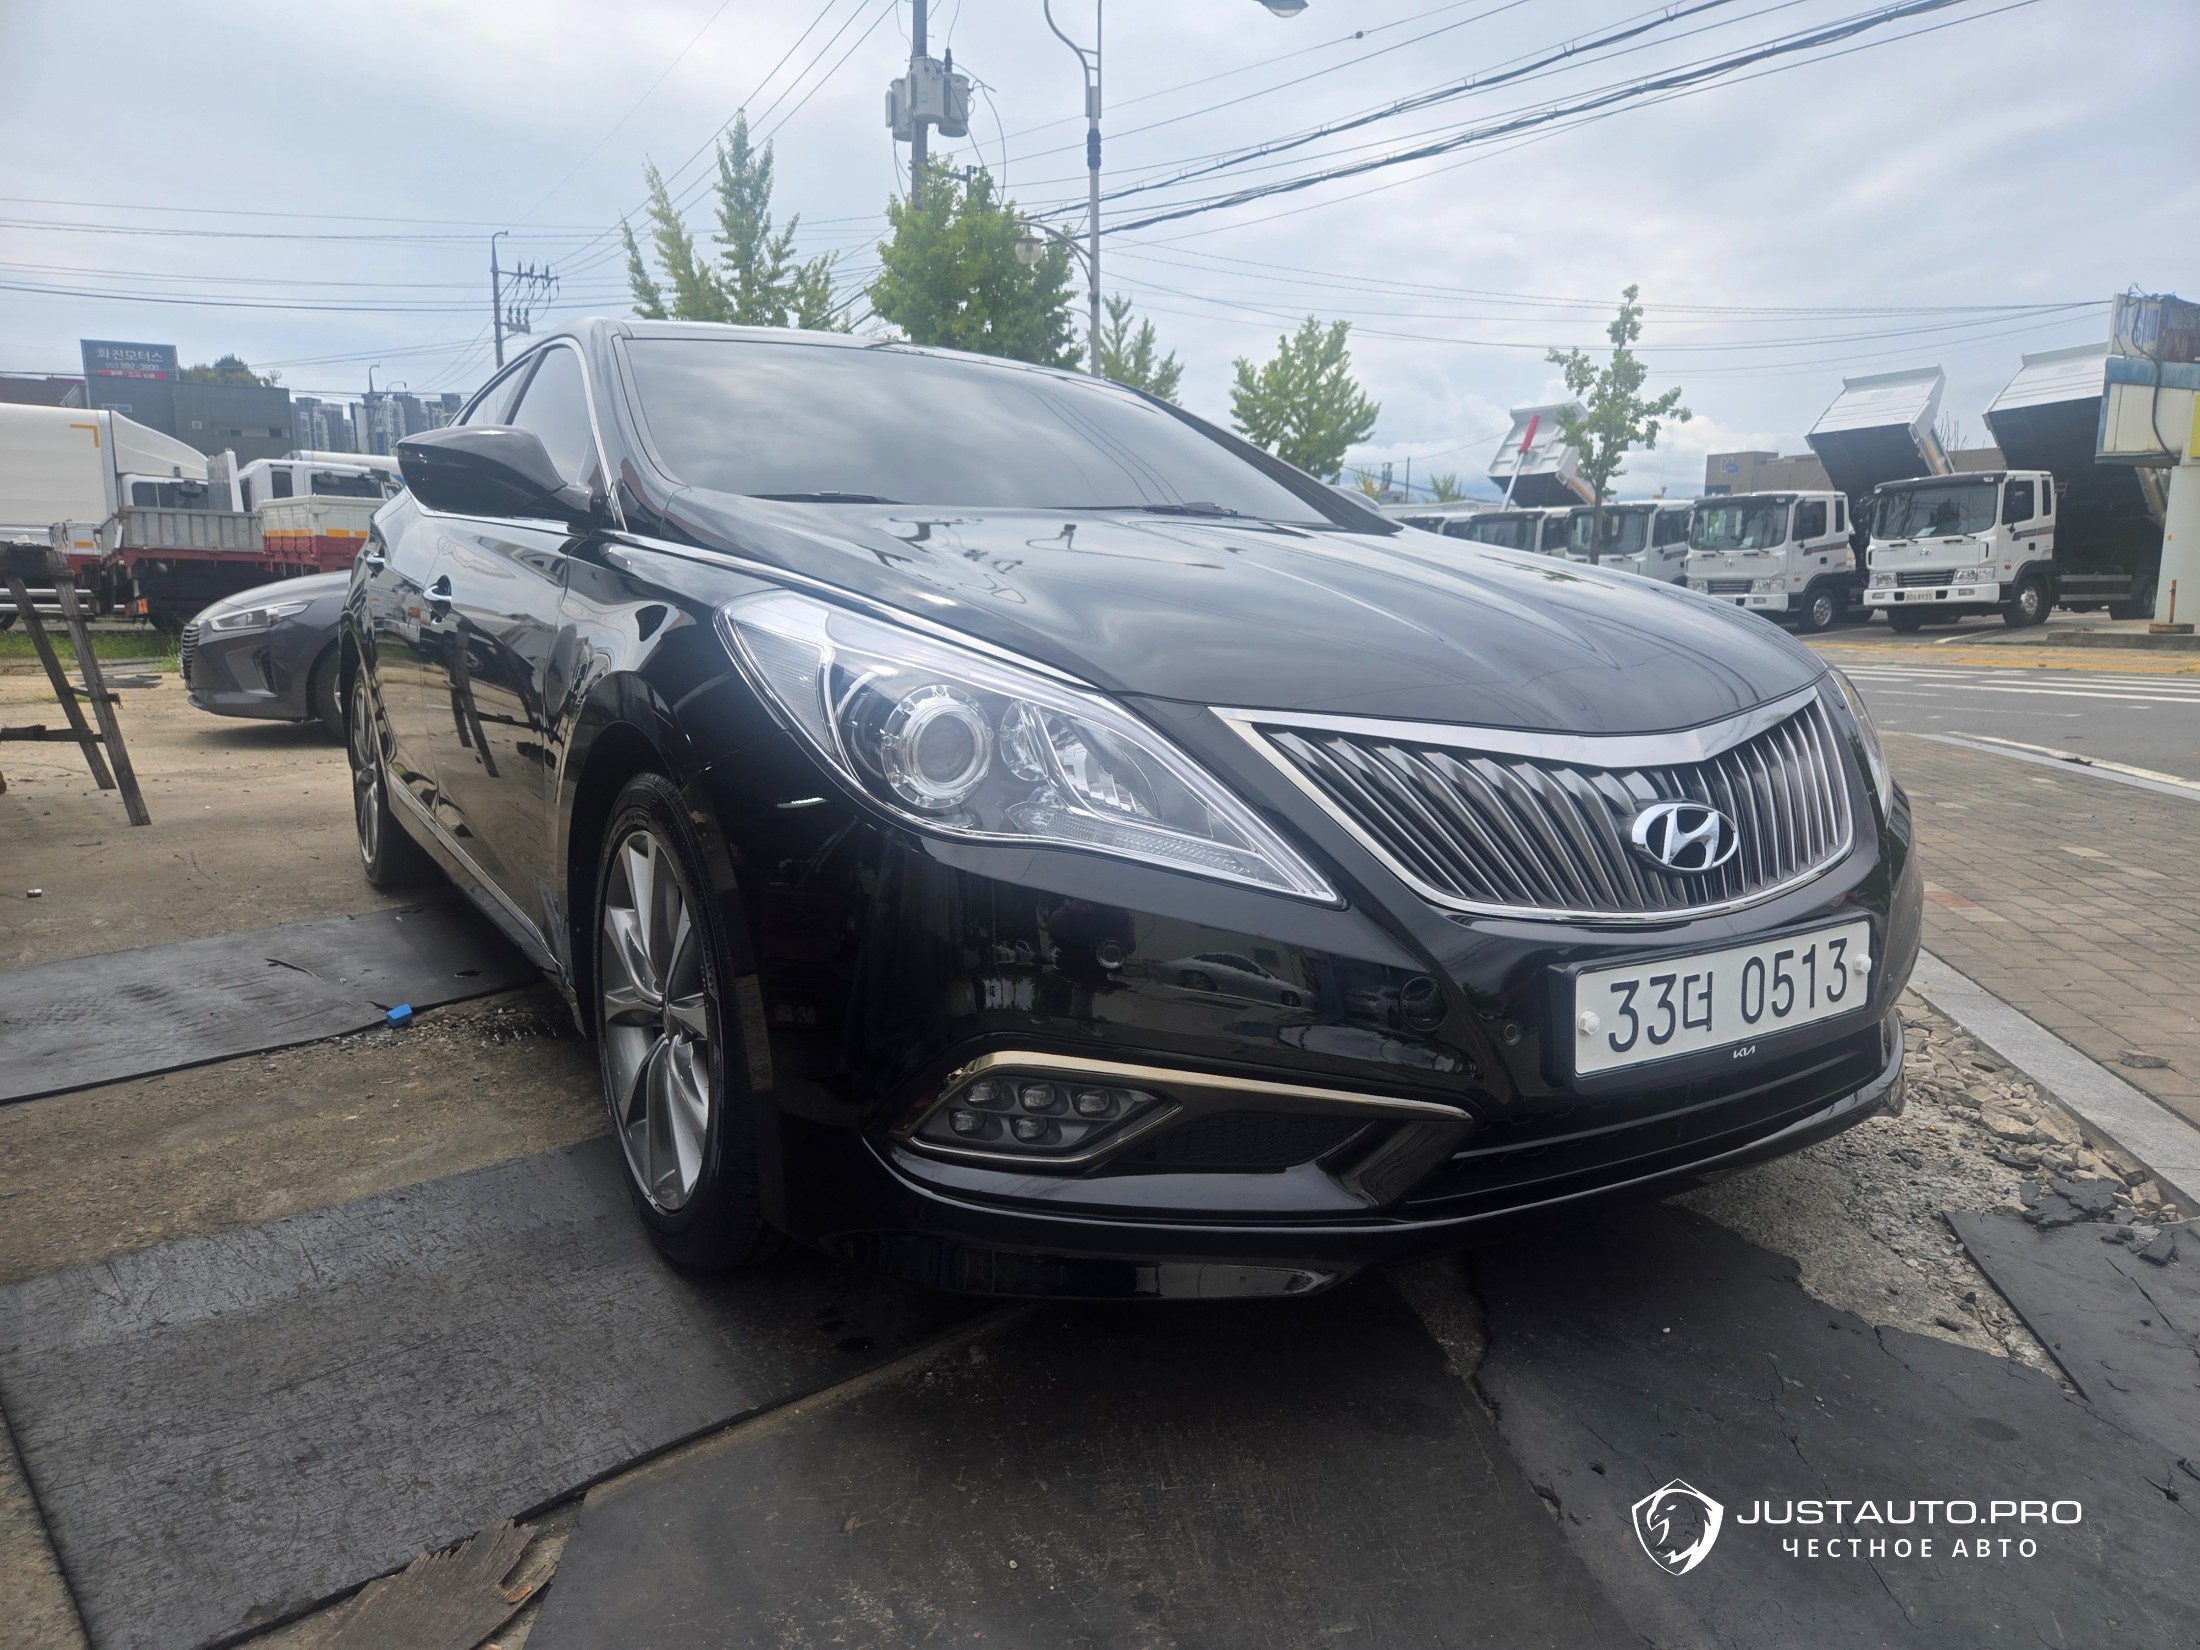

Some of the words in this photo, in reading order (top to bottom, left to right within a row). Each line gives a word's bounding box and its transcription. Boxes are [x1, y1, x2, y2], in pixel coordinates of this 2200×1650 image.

[97, 348, 164, 362] 화진모터스
[1608, 971, 1713, 1052] 33더
[1741, 937, 1848, 1024] 0513
[1733, 1045, 1756, 1059] KIA
